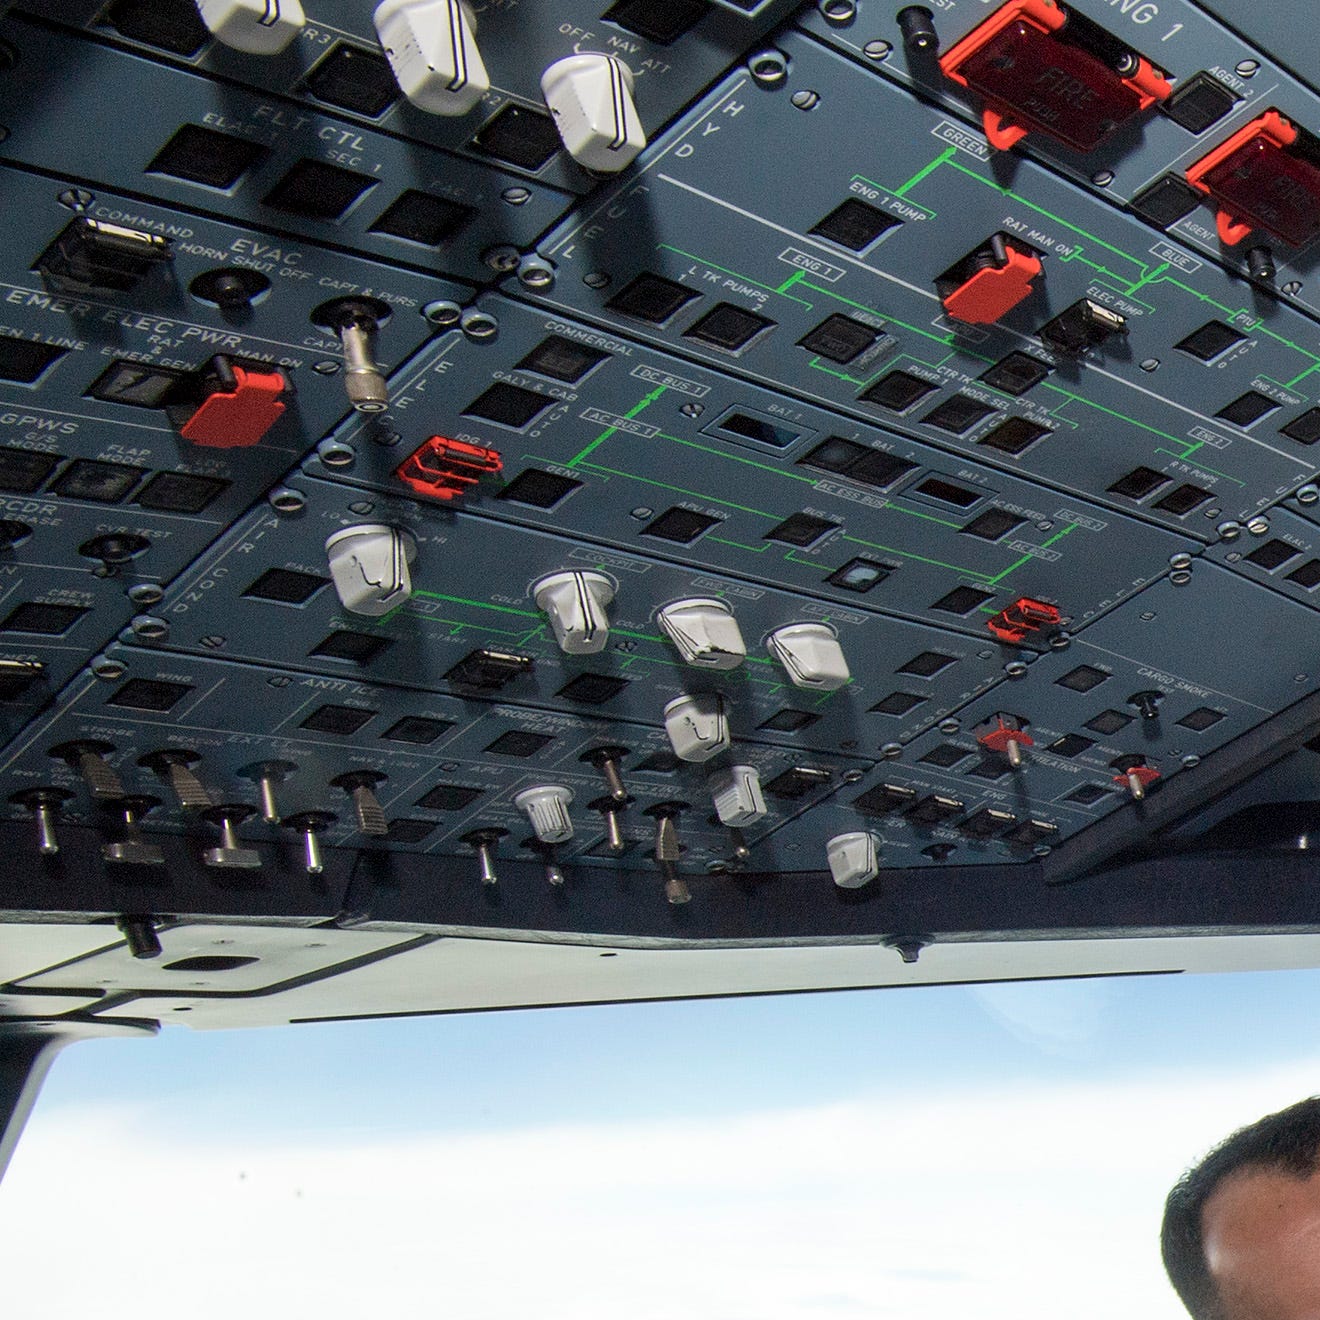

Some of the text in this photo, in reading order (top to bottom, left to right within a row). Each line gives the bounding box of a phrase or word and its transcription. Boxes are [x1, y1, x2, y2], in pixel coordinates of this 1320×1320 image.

[558, 23, 596, 41] OFF
[1161, 23, 1184, 42] 1
[607, 36, 640, 54] NAV
[641, 58, 672, 74] ATT
[1208, 66, 1245, 90] AGENT
[317, 126, 365, 151] CTL
[674, 100, 745, 158] HYD
[942, 126, 988, 156] GREEN
[325, 149, 363, 168] SEC
[849, 181, 927, 222] ENG PUMP
[95, 206, 196, 239] COMMAND
[1182, 220, 1217, 241] AGENT
[1002, 216, 1074, 256] RAT MAN ON
[178, 242, 314, 281] HORN SHUT OFF
[230, 238, 304, 266] EVAC
[1162, 248, 1191, 268] BLUE
[792, 254, 820, 272] ENG
[318, 276, 420, 308] CAPT PURS
[688, 265, 770, 304] L TK PUMPS
[1086, 286, 1144, 318] ELEC PUMP
[5, 290, 244, 348] EMER ELEC PWR
[1235, 314, 1257, 328] PTU
[44, 336, 90, 352] LINE
[146, 334, 185, 348] RAT
[544, 321, 634, 358] COMMERCIAL
[101, 346, 198, 371] EMER GEN
[236, 349, 304, 369] MAN ON
[640, 368, 692, 391] DC BUS
[907, 364, 940, 382] PUMP
[936, 366, 974, 386] CTR TK
[492, 370, 579, 402] GALY CAB
[1250, 378, 1269, 392] ENG
[958, 384, 1011, 412] MODE SEL
[1014, 398, 1052, 416] CTR TK
[767, 402, 794, 418] BAT
[0, 412, 80, 435] GPWS
[590, 412, 642, 432] AC BUS
[454, 432, 480, 446] IDG
[871, 440, 896, 452] BAT
[96, 453, 146, 466] MODE
[106, 444, 152, 457] FLAP
[957, 468, 981, 482] BAT
[820, 480, 837, 492] AC
[706, 507, 730, 520] GEN
[156, 672, 194, 683] WING
[1136, 668, 1213, 698] CARGO SMOKE
[299, 678, 384, 698] ANTI ICE
